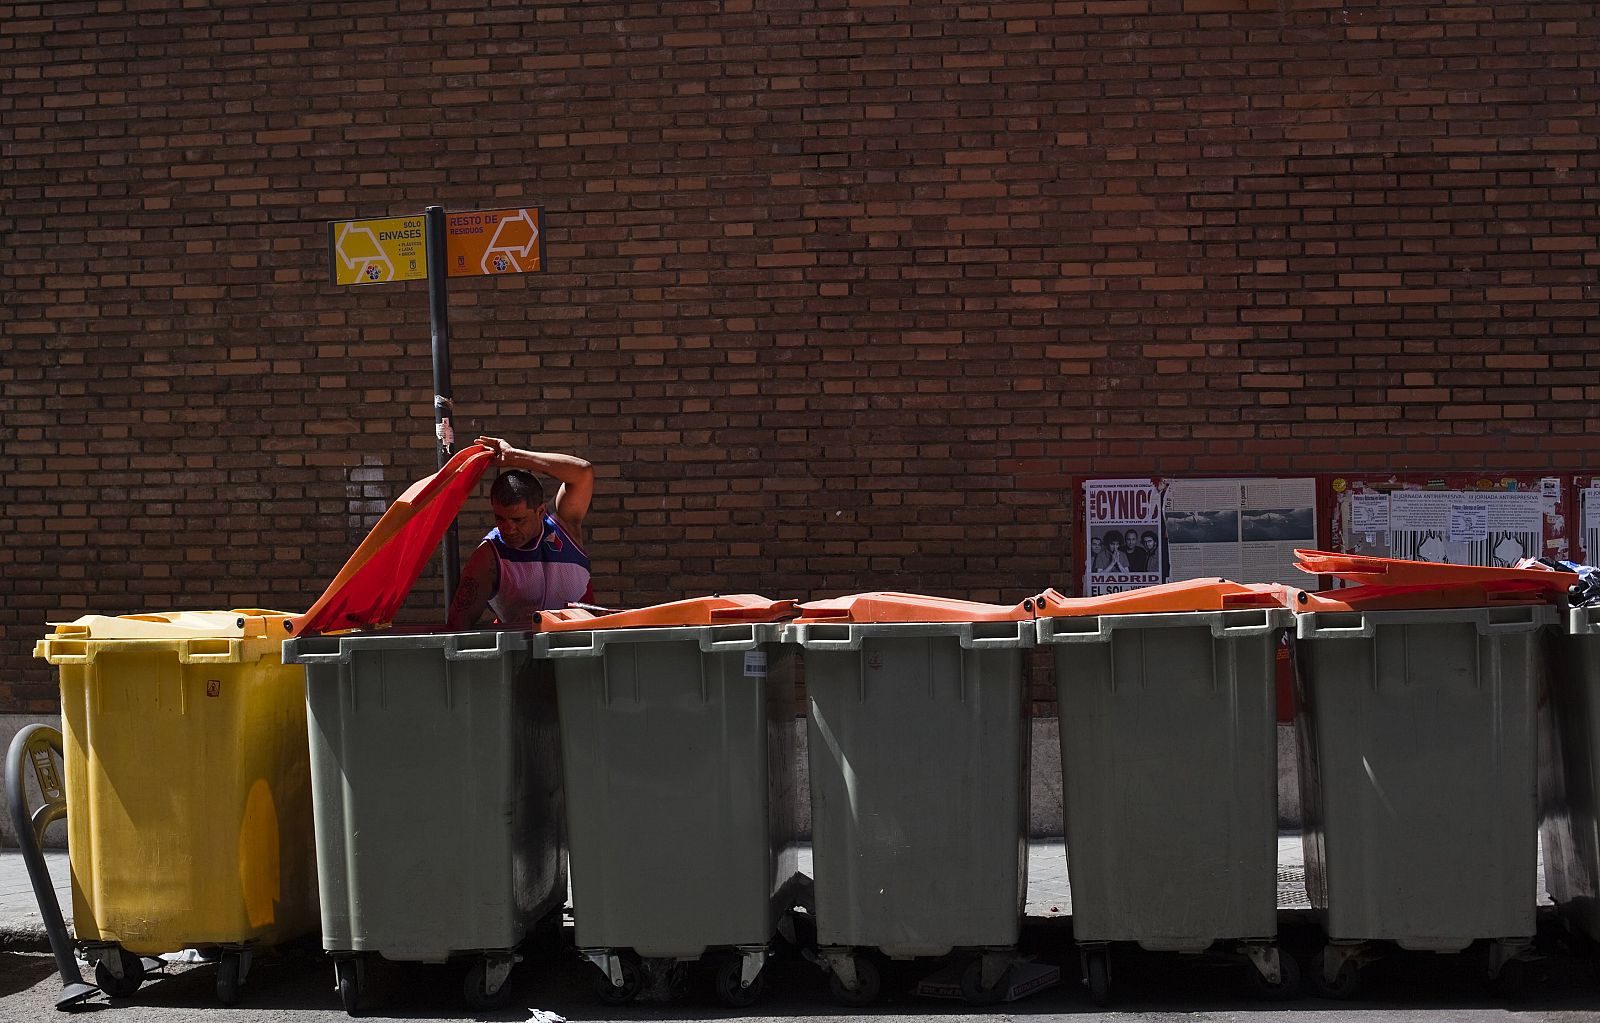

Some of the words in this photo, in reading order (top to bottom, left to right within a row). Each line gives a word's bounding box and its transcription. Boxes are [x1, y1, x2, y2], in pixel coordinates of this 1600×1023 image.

[403, 220, 421, 229] SÓLO
[450, 216, 481, 226] RESTO
[484, 215, 498, 224] DE
[379, 229, 422, 241] ENVASES
[450, 227, 483, 235] RESIDUOS
[1091, 575, 1159, 583] MADRID
[1091, 585, 1104, 597] EL
